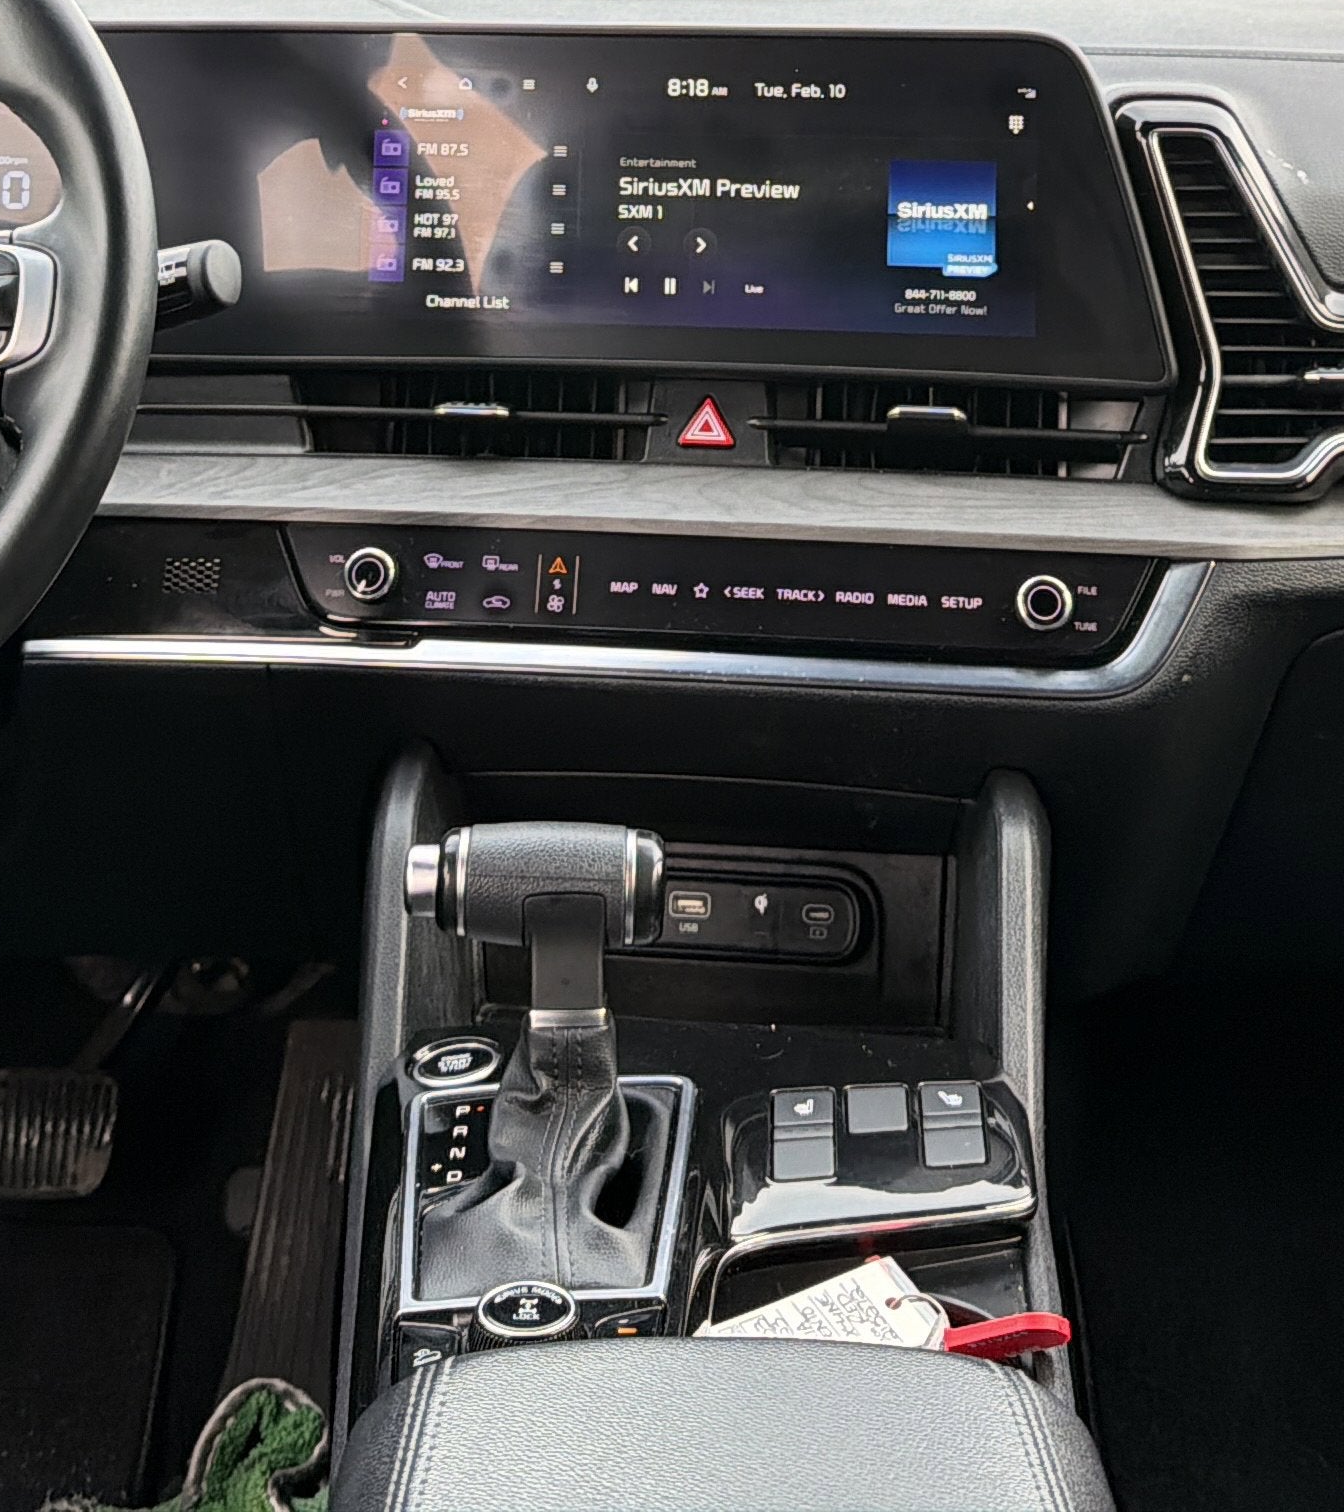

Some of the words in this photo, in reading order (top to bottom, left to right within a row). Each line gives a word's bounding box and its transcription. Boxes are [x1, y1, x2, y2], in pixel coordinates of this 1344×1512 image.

[667, 78, 709, 97] 8:18
[711, 86, 728, 97] AM
[791, 83, 825, 99] Feb.
[828, 84, 847, 98] 10
[417, 143, 438, 156] FM
[440, 143, 469, 156] 87.5
[619, 156, 697, 169] Entertainment
[415, 175, 455, 187] Loved
[619, 176, 711, 197] SiriusXM
[716, 178, 800, 199] Preview
[415, 189, 434, 200] FM
[435, 189, 460, 200] 95.5
[618, 204, 653, 219] SXM
[656, 205, 663, 219] 1
[897, 201, 988, 220] SiriusXM
[414, 213, 440, 225] HOT
[443, 214, 459, 225] 97
[413, 227, 432, 238] FM
[433, 227, 456, 239] 97.1
[412, 258, 434, 271] FM
[435, 259, 465, 272] 92.3
[744, 284, 764, 294] Live
[904, 288, 977, 302] 844-711-8800
[425, 294, 481, 308] Channel
[483, 296, 511, 310] List
[894, 303, 926, 314] Great
[928, 303, 957, 315] Offer
[960, 304, 988, 316] Now!
[329, 554, 345, 564] VOL
[610, 581, 639, 594] MAP
[651, 583, 678, 595] NAV
[733, 586, 765, 599] SEEK
[1077, 585, 1097, 596] FILE
[426, 590, 456, 602] AUTO
[776, 588, 817, 602] TRACK
[835, 591, 874, 605] RADIO
[887, 593, 928, 607] MEDIA
[940, 596, 983, 609] SETUP
[1074, 621, 1098, 632] TUNE
[678, 922, 699, 933] USB
[456, 1105, 471, 1118] P
[453, 1125, 468, 1139] R
[449, 1146, 466, 1160] N
[446, 1170, 463, 1184] D
[512, 1313, 541, 1321] LOCK
